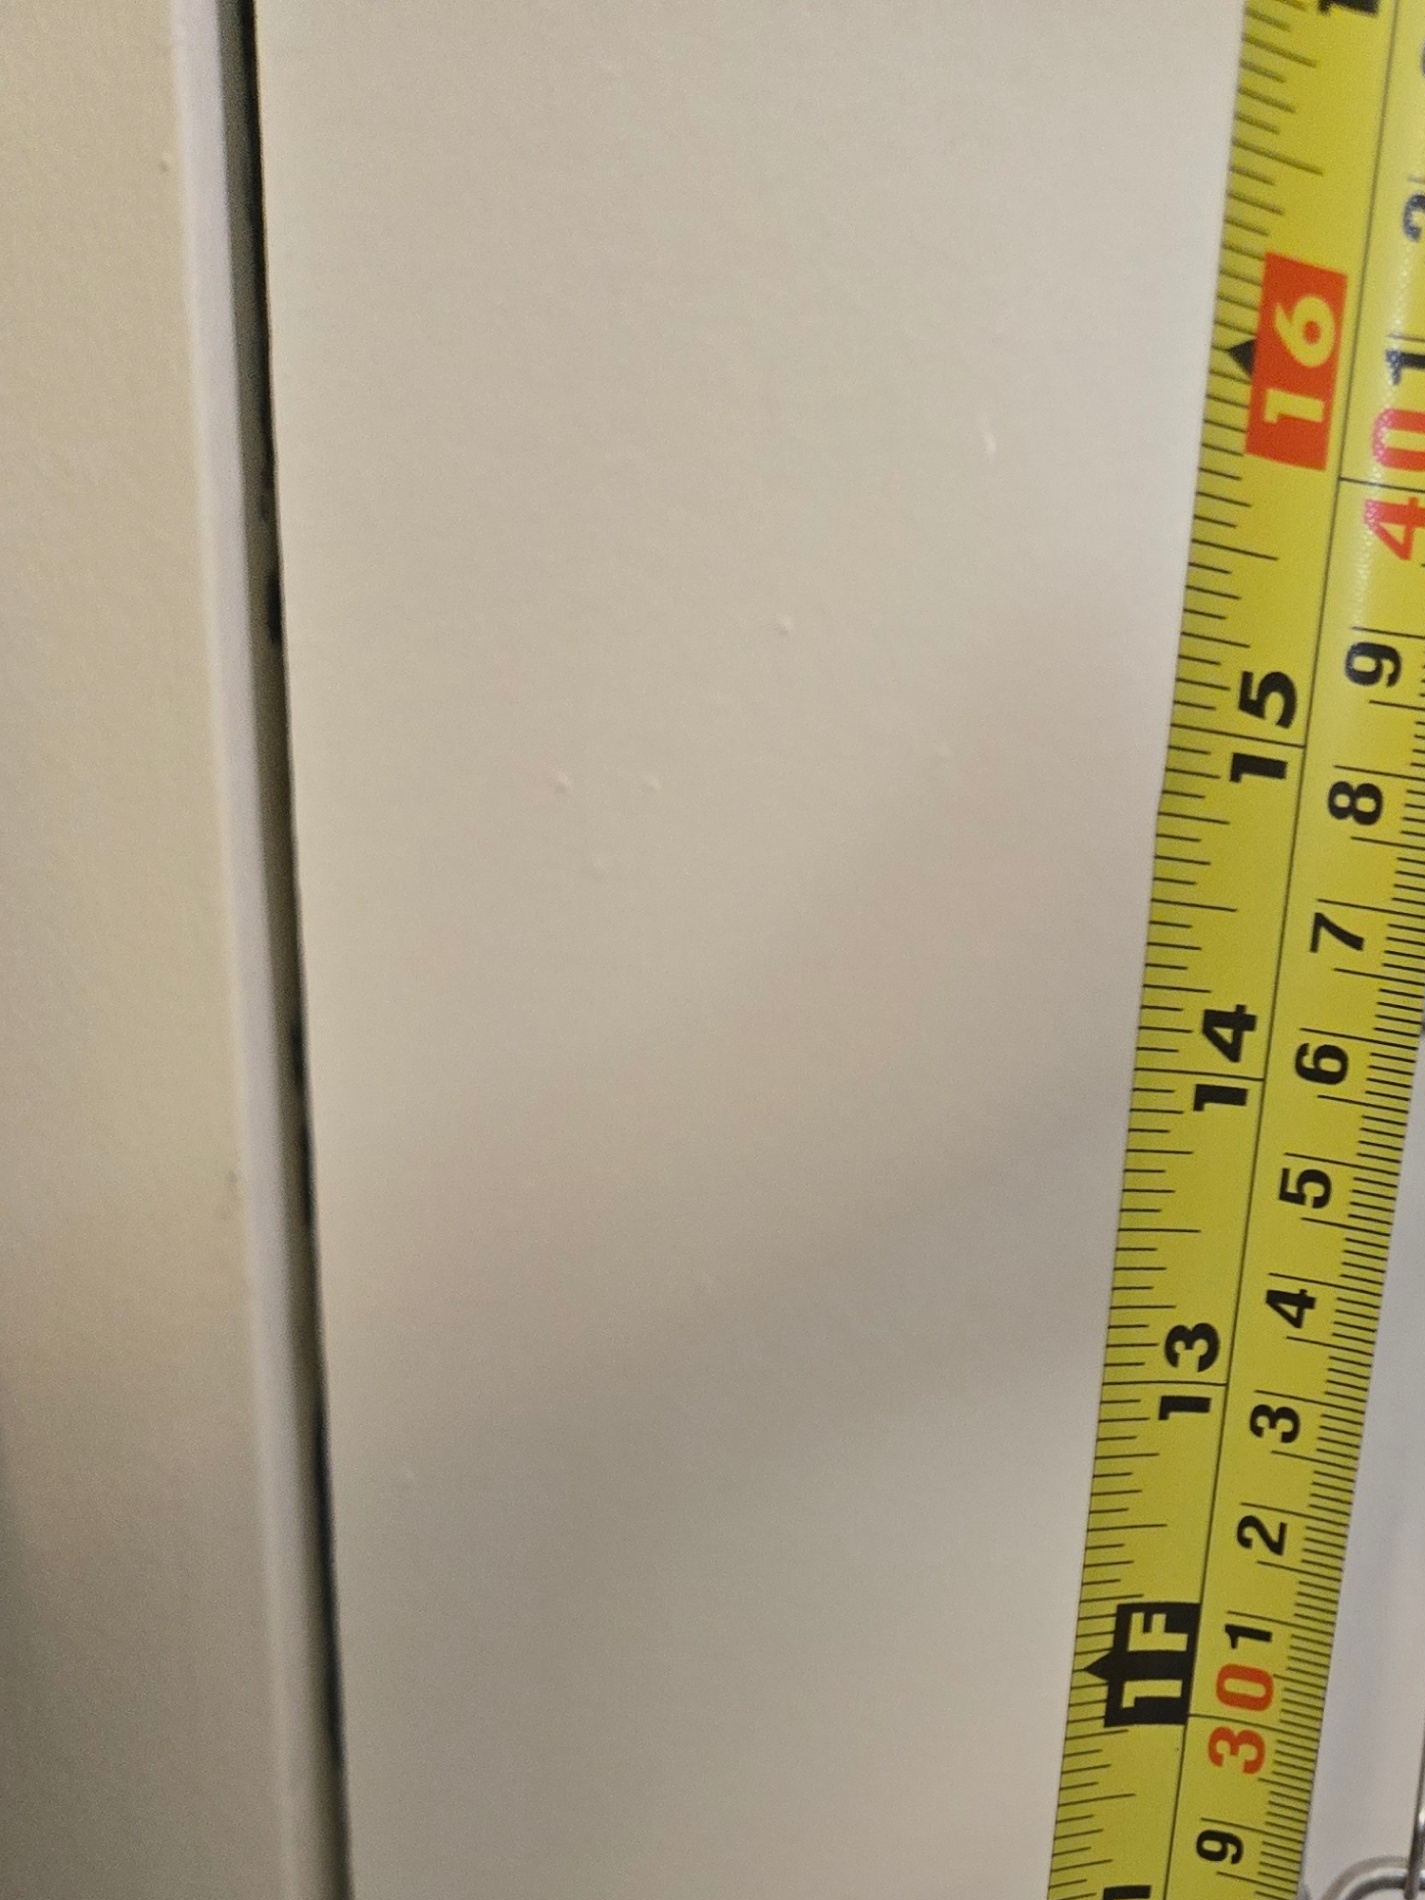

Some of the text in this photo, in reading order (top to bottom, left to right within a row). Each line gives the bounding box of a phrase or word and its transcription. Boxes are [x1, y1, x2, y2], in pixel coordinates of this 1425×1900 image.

[1262, 296, 1335, 423] 16
[1344, 641, 1402, 688] 9
[1229, 671, 1298, 784] 15
[1327, 780, 1384, 826] 8
[1309, 912, 1365, 953] 7
[1193, 1004, 1258, 1112] 14
[1294, 1043, 1349, 1085] 6
[1278, 1167, 1333, 1209] 5
[1265, 1288, 1316, 1329] 4
[1158, 1322, 1221, 1421] 13
[1249, 1404, 1300, 1444] 3
[1236, 1515, 1287, 1556] 2
[1225, 1623, 1273, 1649] 1
[1121, 1611, 1188, 1709] 1F
[1207, 1663, 1275, 1775] 30
[1196, 1829, 1244, 1865] 9
